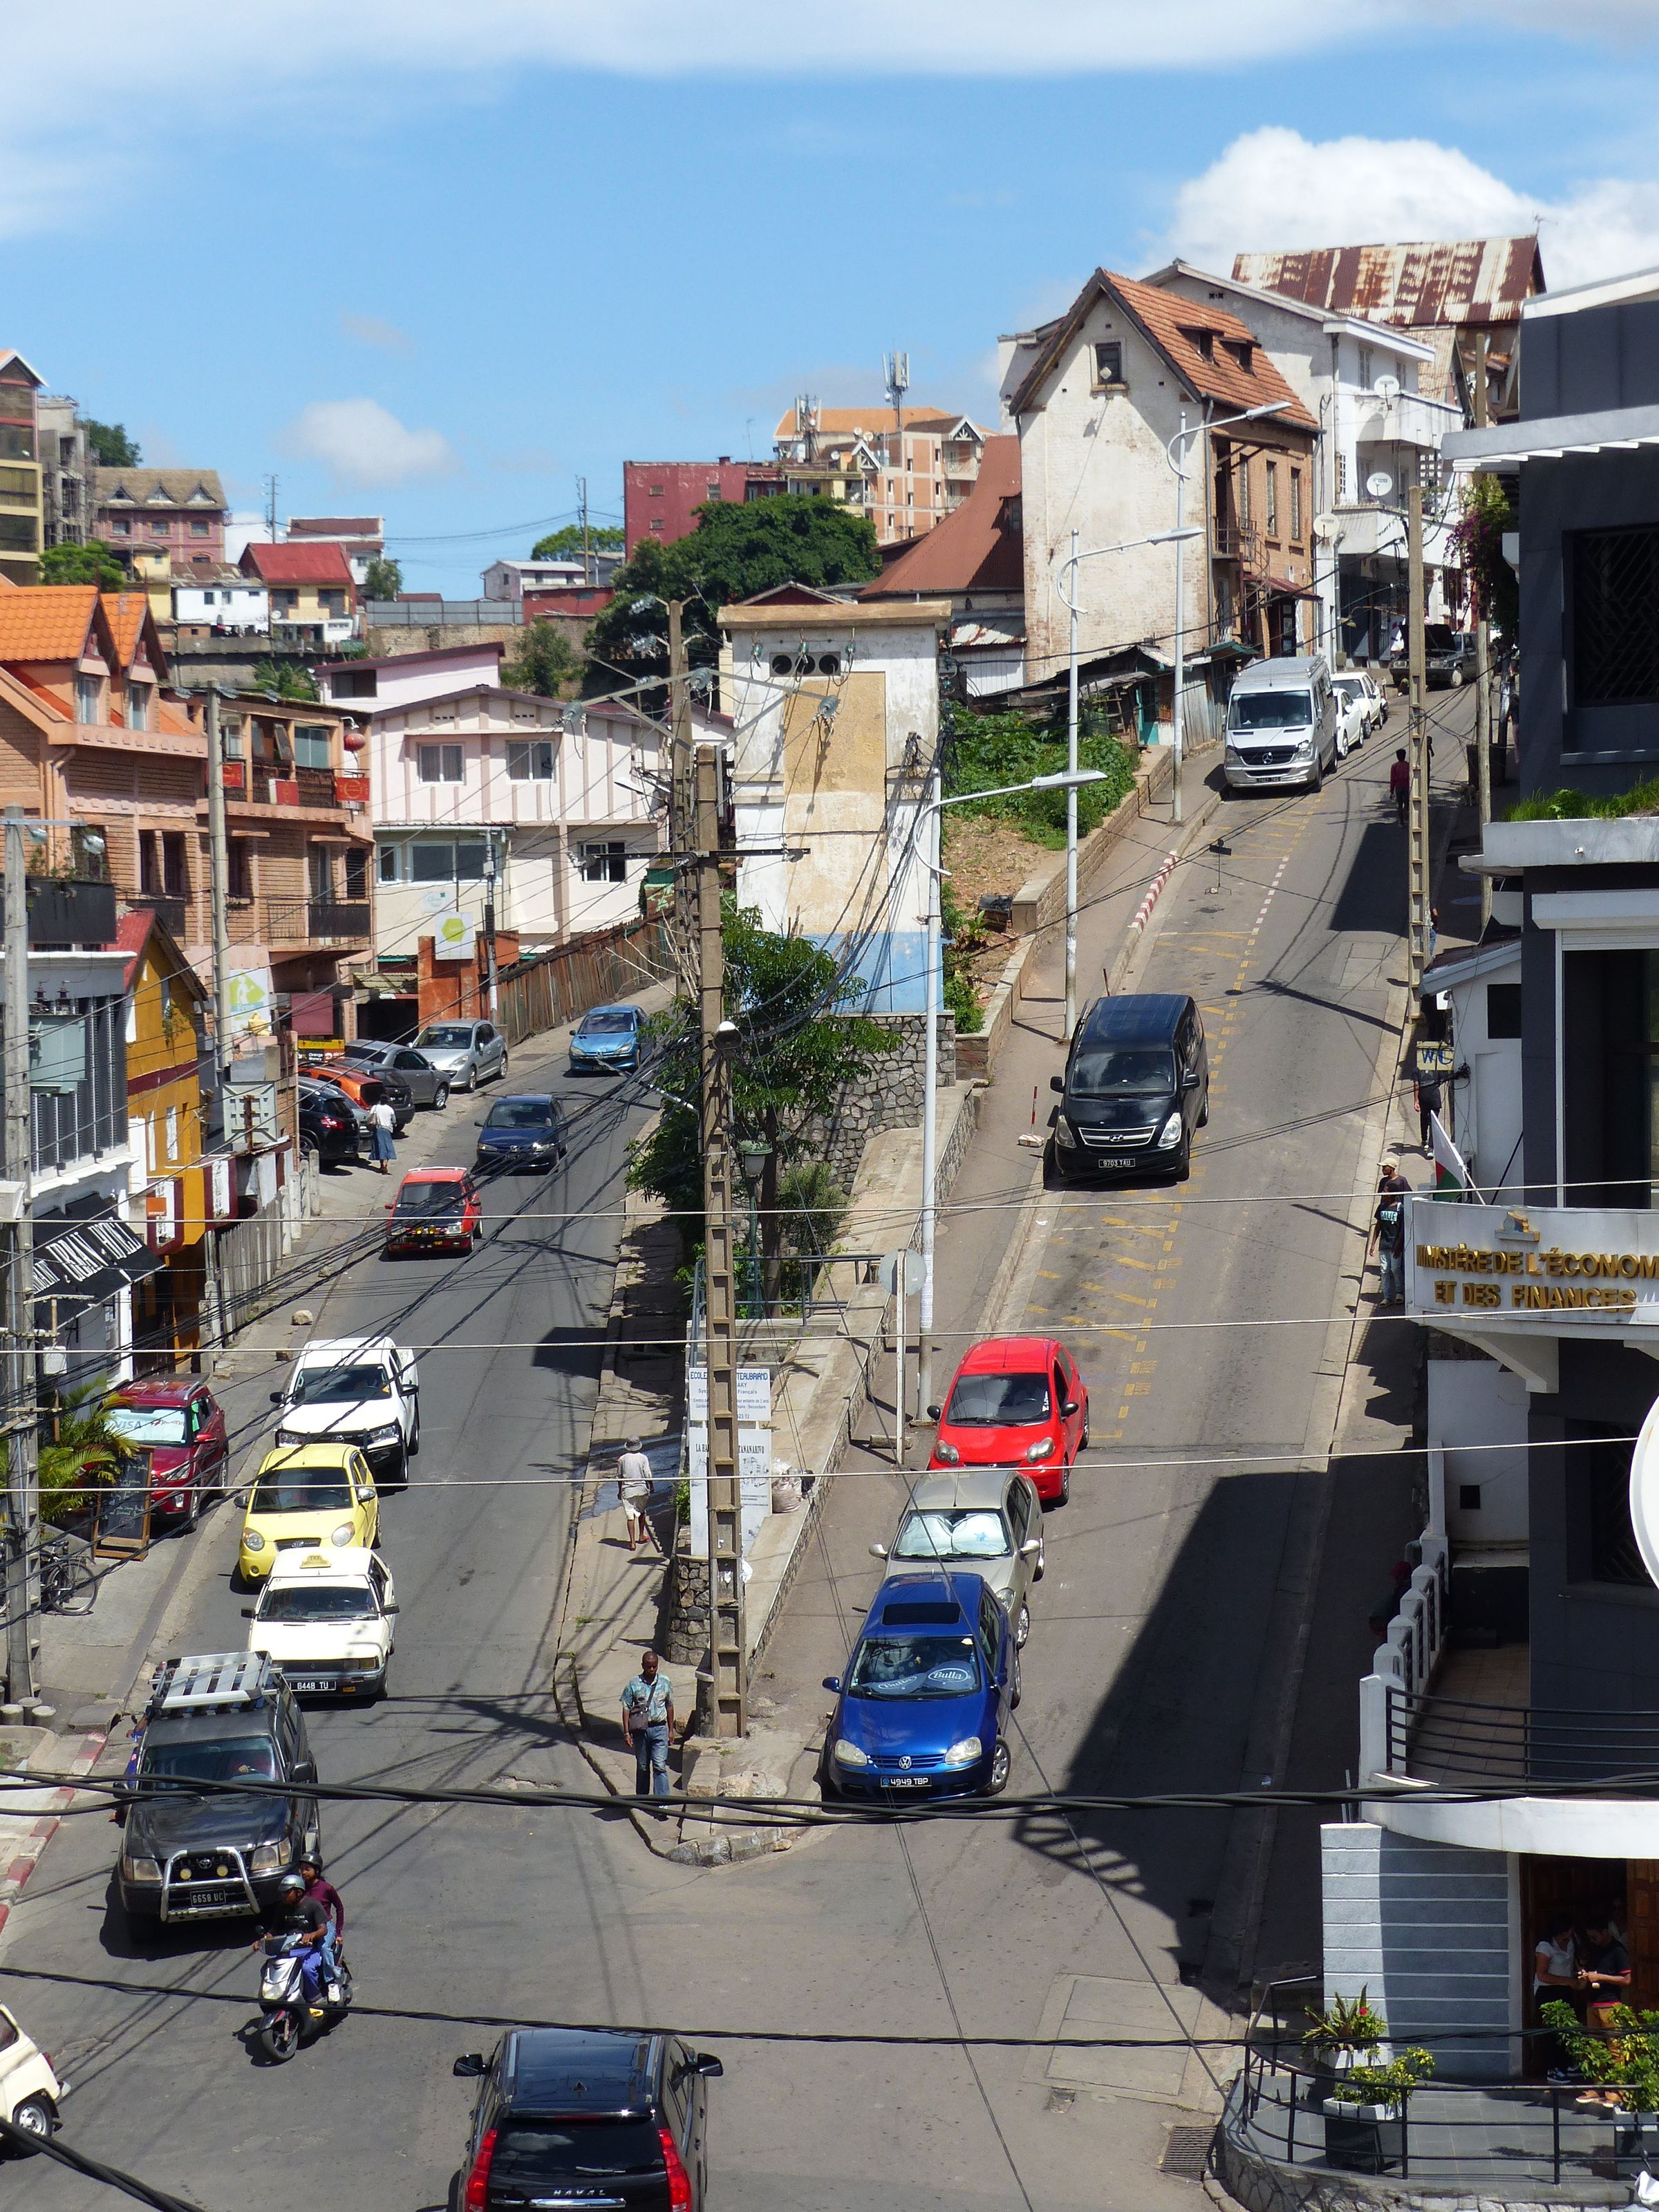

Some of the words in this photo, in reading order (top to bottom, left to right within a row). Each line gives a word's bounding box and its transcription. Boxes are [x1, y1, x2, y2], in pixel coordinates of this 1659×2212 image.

[1422, 1048, 1453, 1065] WC
[1492, 1250, 1524, 1275] DE
[1434, 1281, 1457, 1304] ET
[1462, 1282, 1501, 1308] DES
[1512, 1284, 1637, 1313] FINANCES
[690, 1371, 708, 1380] ECOLE
[114, 1421, 142, 1430] VISA
[934, 1671, 964, 1680] Bulla
[192, 1893, 212, 1904] 6658
[214, 1892, 224, 1902] UC
